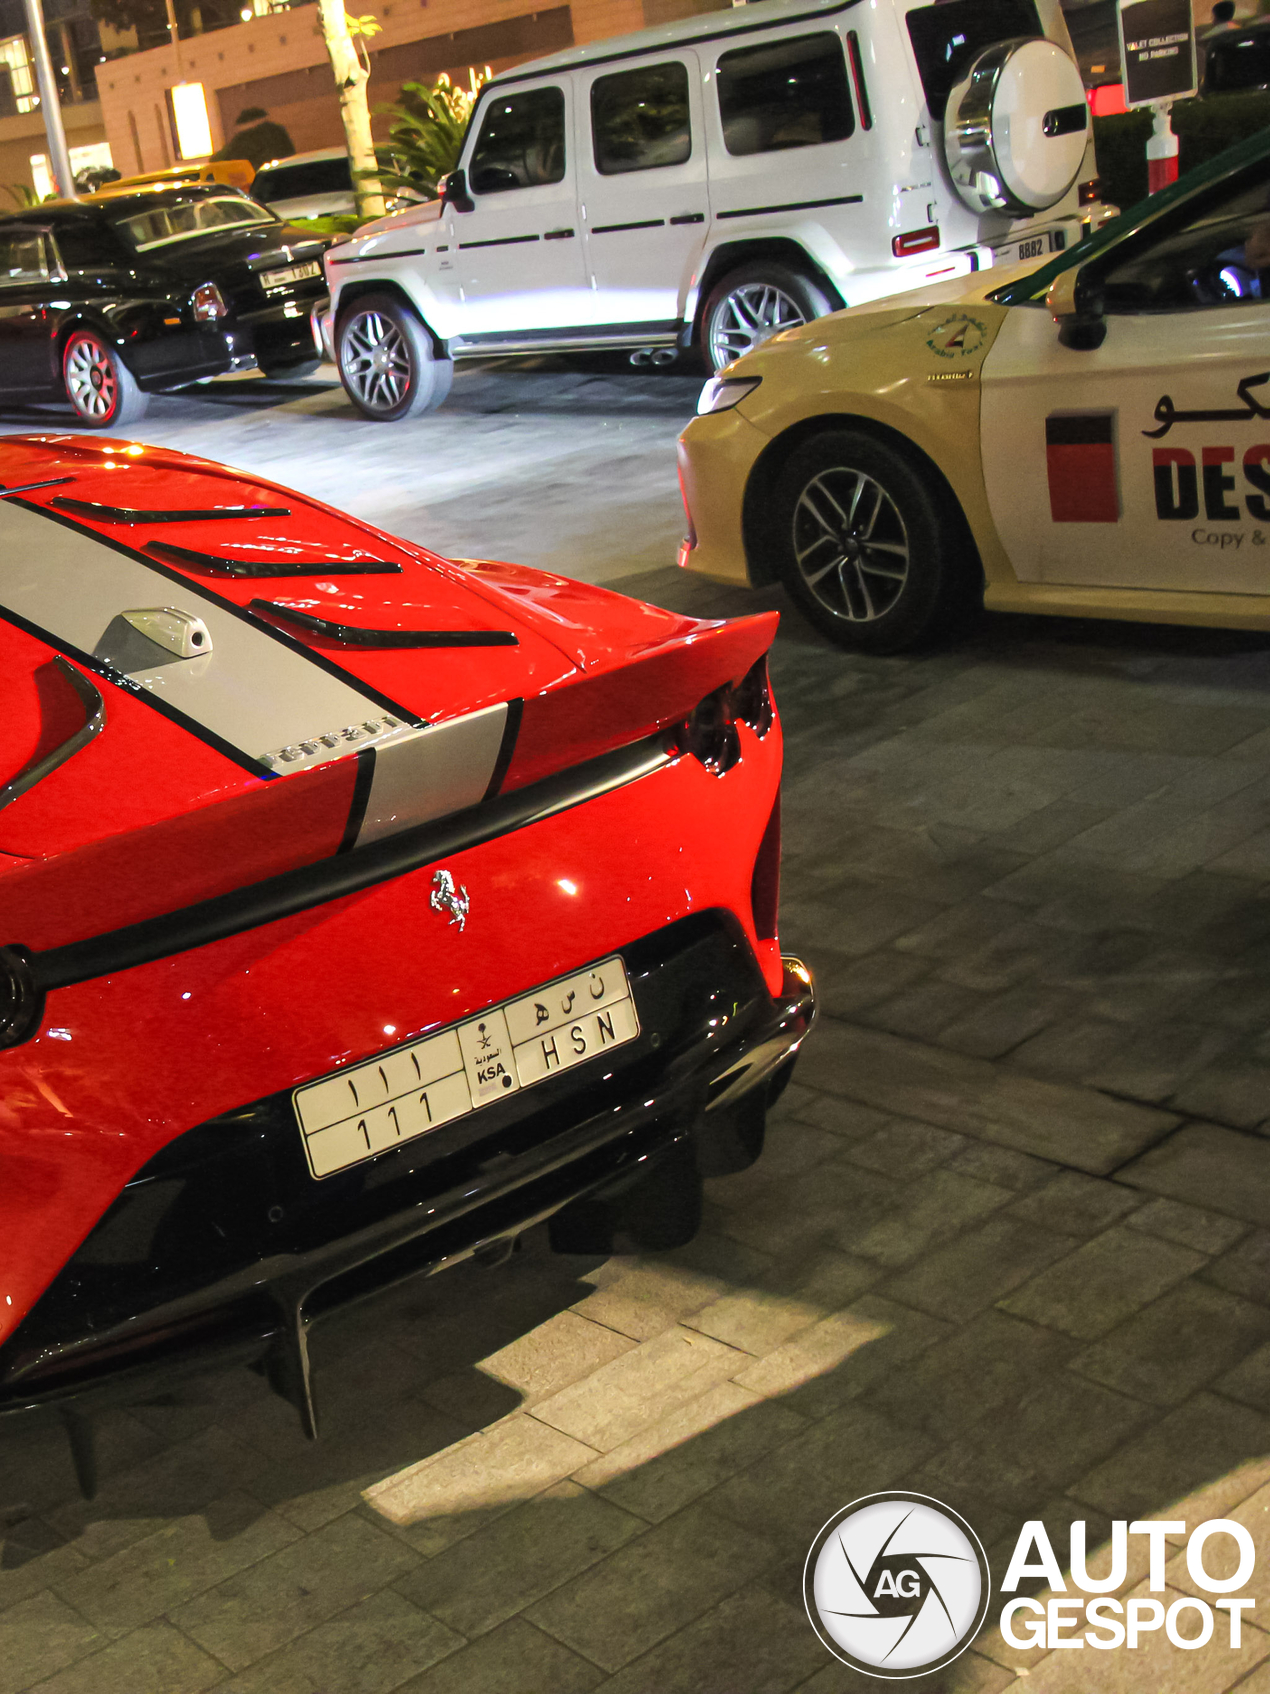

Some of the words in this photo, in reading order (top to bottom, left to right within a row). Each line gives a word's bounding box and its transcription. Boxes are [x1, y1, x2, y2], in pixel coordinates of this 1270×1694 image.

[1191, 528, 1245, 549] Copy
[1251, 529, 1266, 546] &
[477, 1062, 506, 1084] KSA
[357, 1092, 431, 1149] 111
